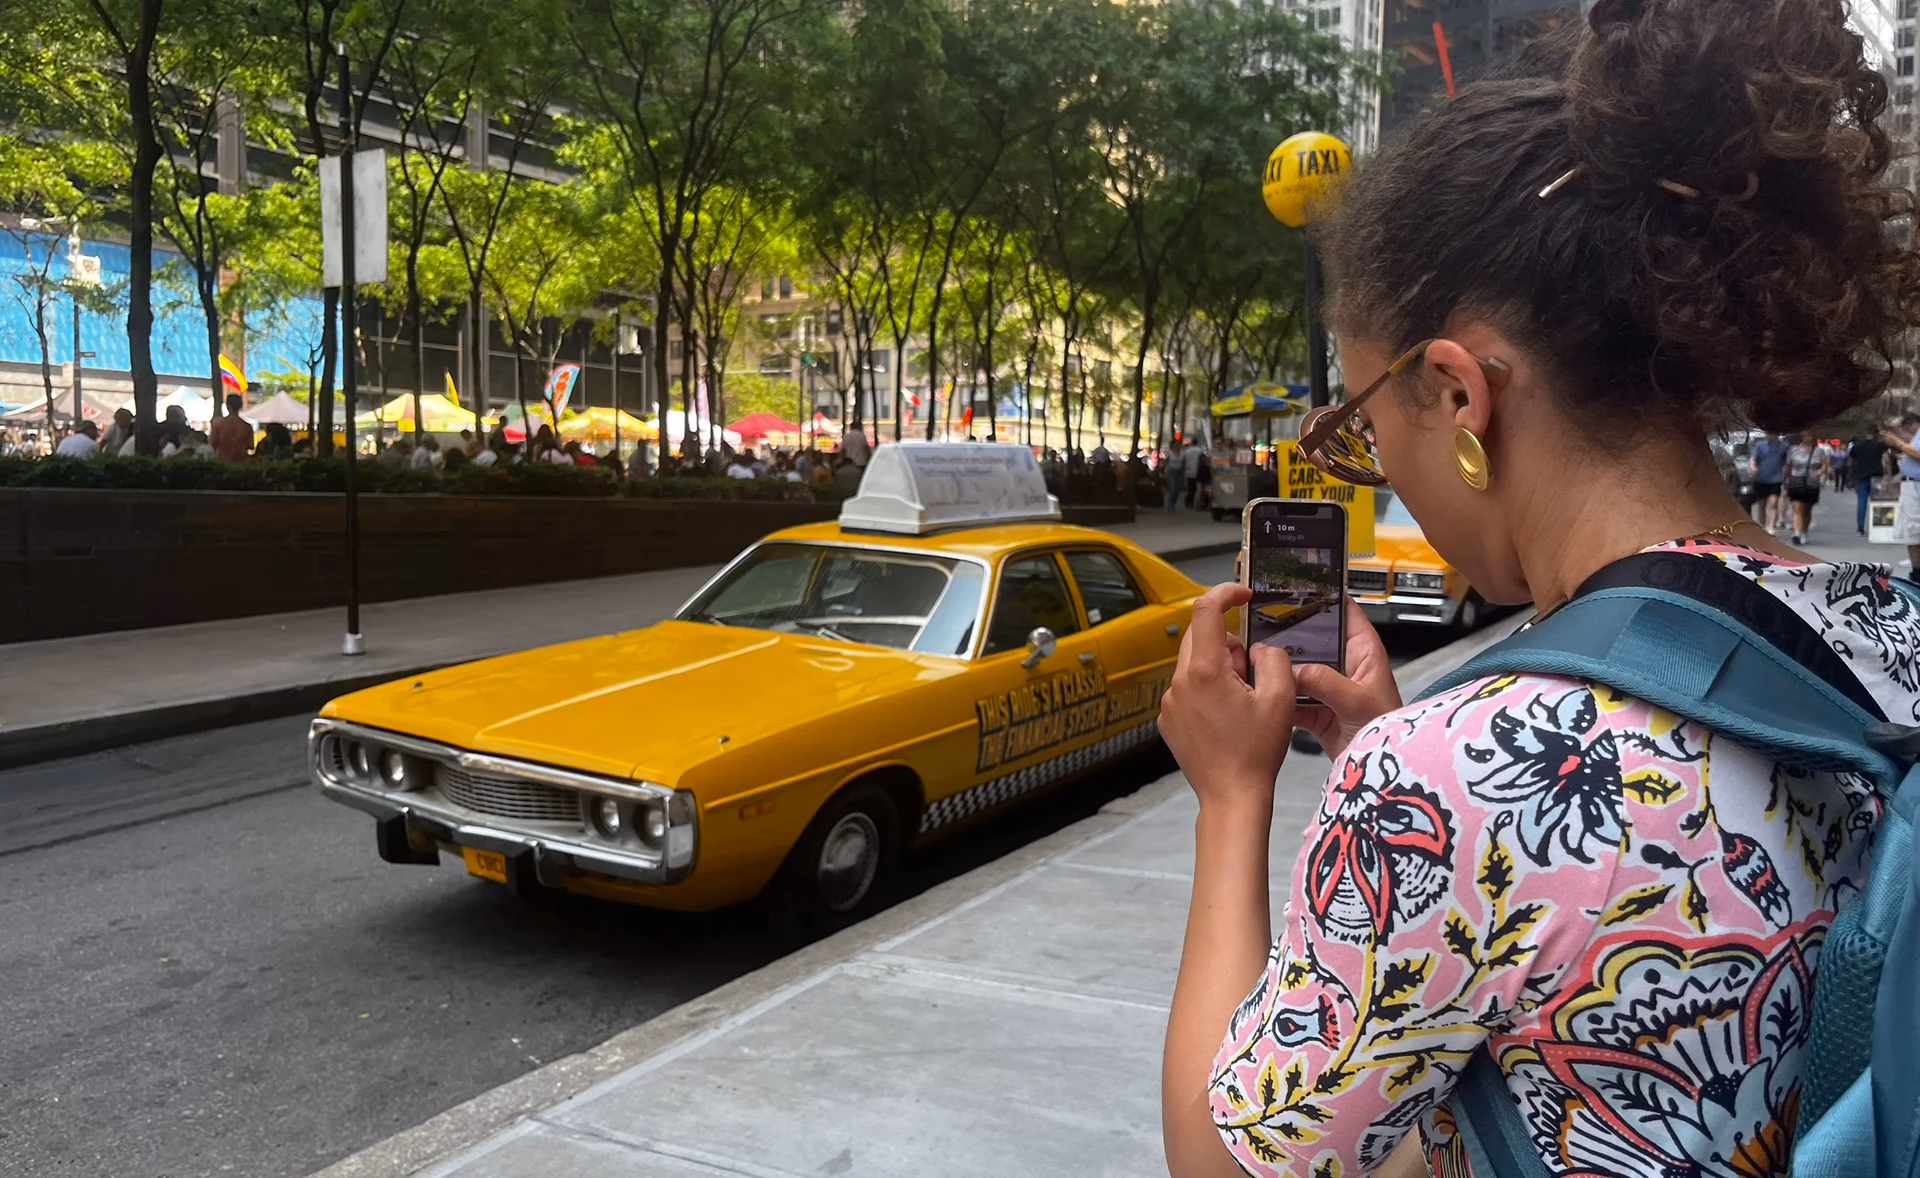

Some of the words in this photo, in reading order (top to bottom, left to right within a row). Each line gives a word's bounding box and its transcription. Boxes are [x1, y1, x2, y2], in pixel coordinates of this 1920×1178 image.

[1297, 149, 1340, 178] TAXI
[1289, 467, 1326, 486] CABS.
[1290, 487, 1314, 499] NOT
[1320, 485, 1356, 502] YOUR
[977, 695, 1010, 734] THIS
